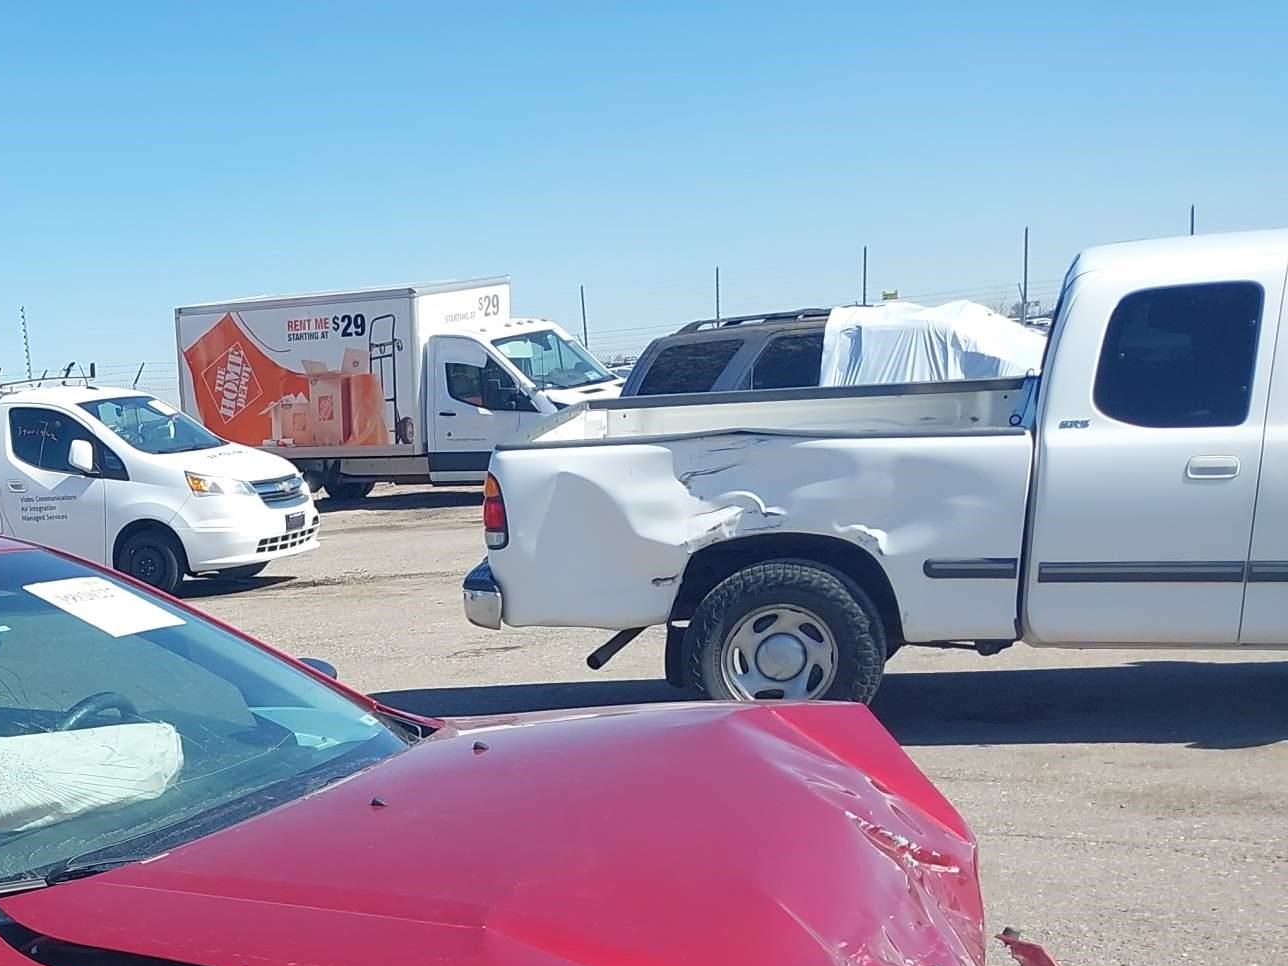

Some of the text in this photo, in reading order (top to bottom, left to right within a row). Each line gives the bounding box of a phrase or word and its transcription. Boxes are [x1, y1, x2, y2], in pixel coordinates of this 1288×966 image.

[287, 313, 366, 337] RENT ME $29
[287, 331, 329, 342] STARTING AT
[215, 366, 226, 393] THE
[221, 347, 244, 418] HOME
[236, 361, 252, 409] DEPOT
[22, 514, 46, 522] Managed
